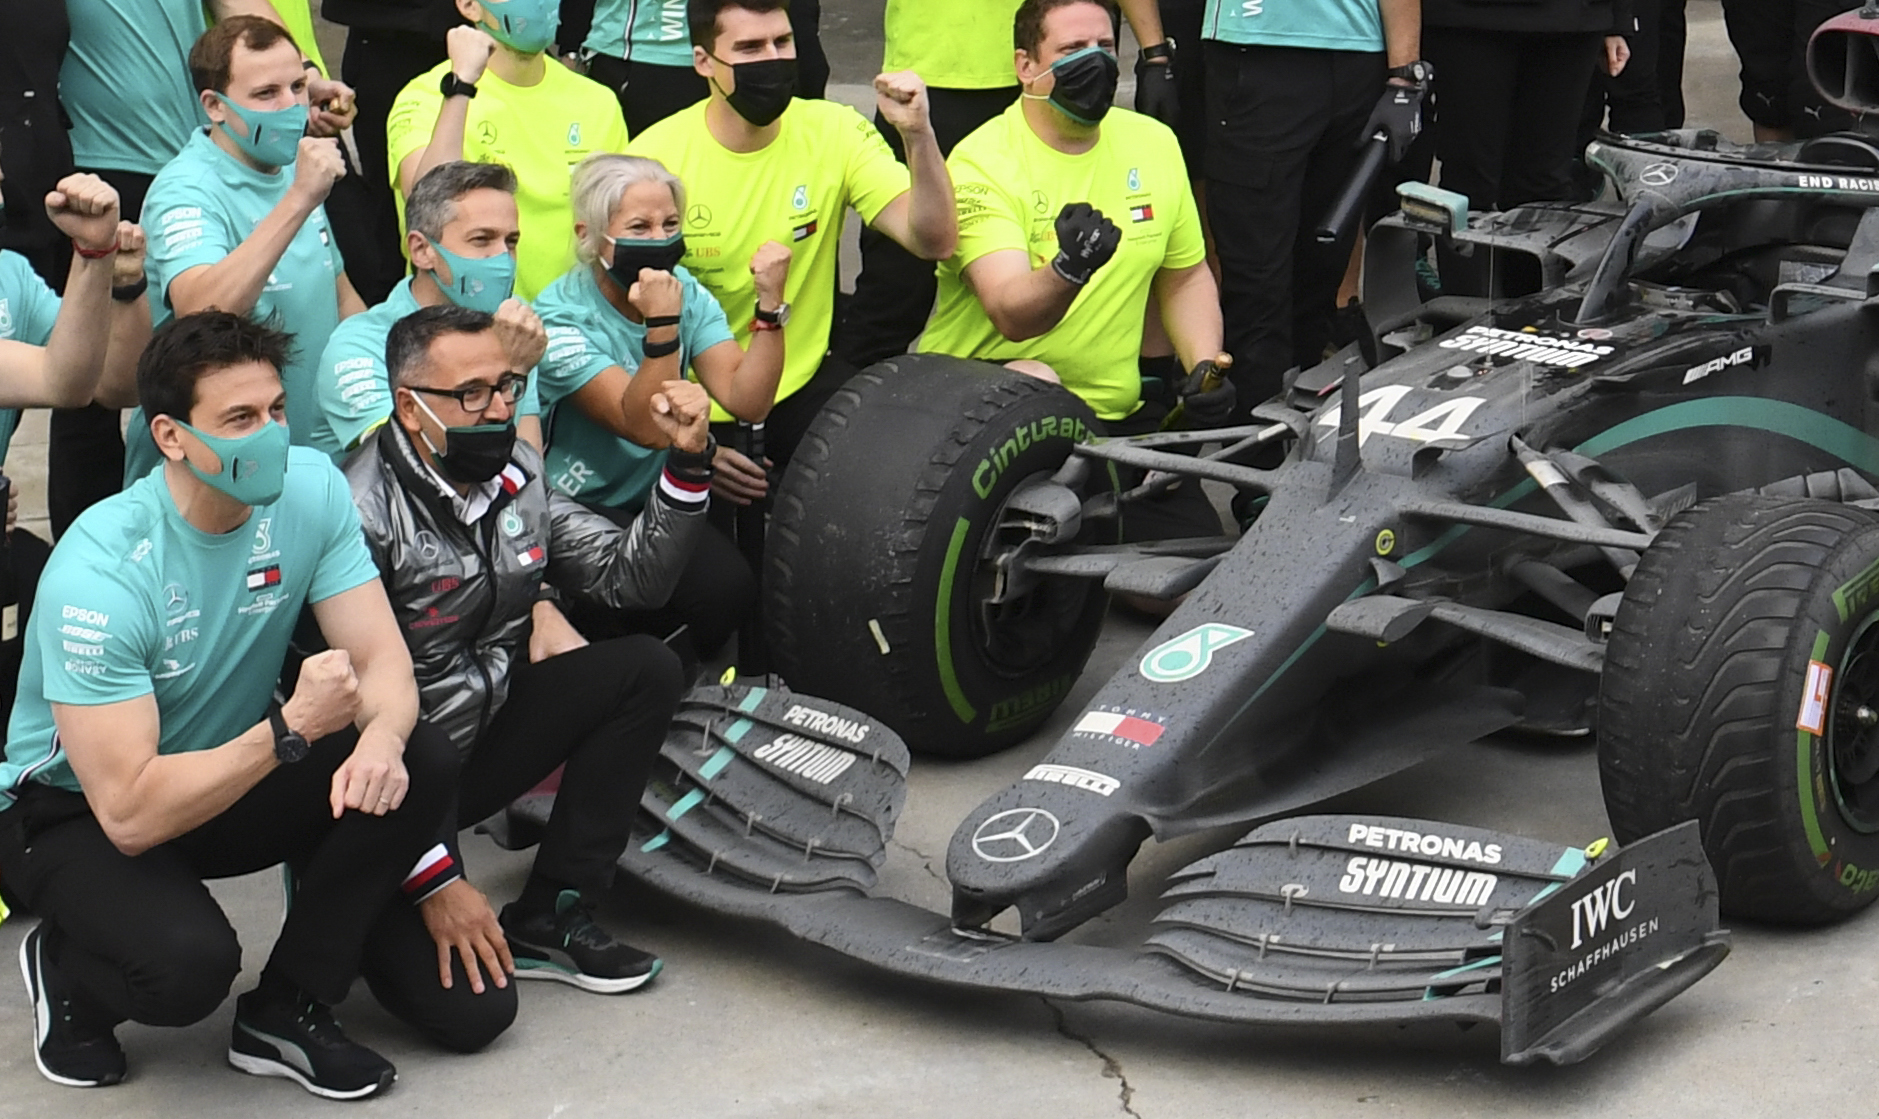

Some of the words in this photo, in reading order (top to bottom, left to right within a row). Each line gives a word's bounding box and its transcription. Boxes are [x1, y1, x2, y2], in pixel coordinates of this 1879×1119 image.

[1798, 175, 1832, 188] END
[695, 247, 721, 258] UBS
[1465, 325, 1615, 355] PETRONAS
[1316, 384, 1487, 448] 44
[431, 577, 459, 594] UBS
[61, 605, 109, 628] EPSON
[783, 704, 870, 745] PETRONAS
[1099, 704, 1167, 724] TOMMY
[1072, 731, 1141, 751] HILFIGER
[753, 733, 858, 785] SYNTIUM
[1348, 823, 1503, 865] PETRONAS
[1339, 856, 1498, 906] SYNTIUM
[1570, 868, 1637, 950] IWC
[1549, 916, 1660, 994] SCHAFFHAUSEN
